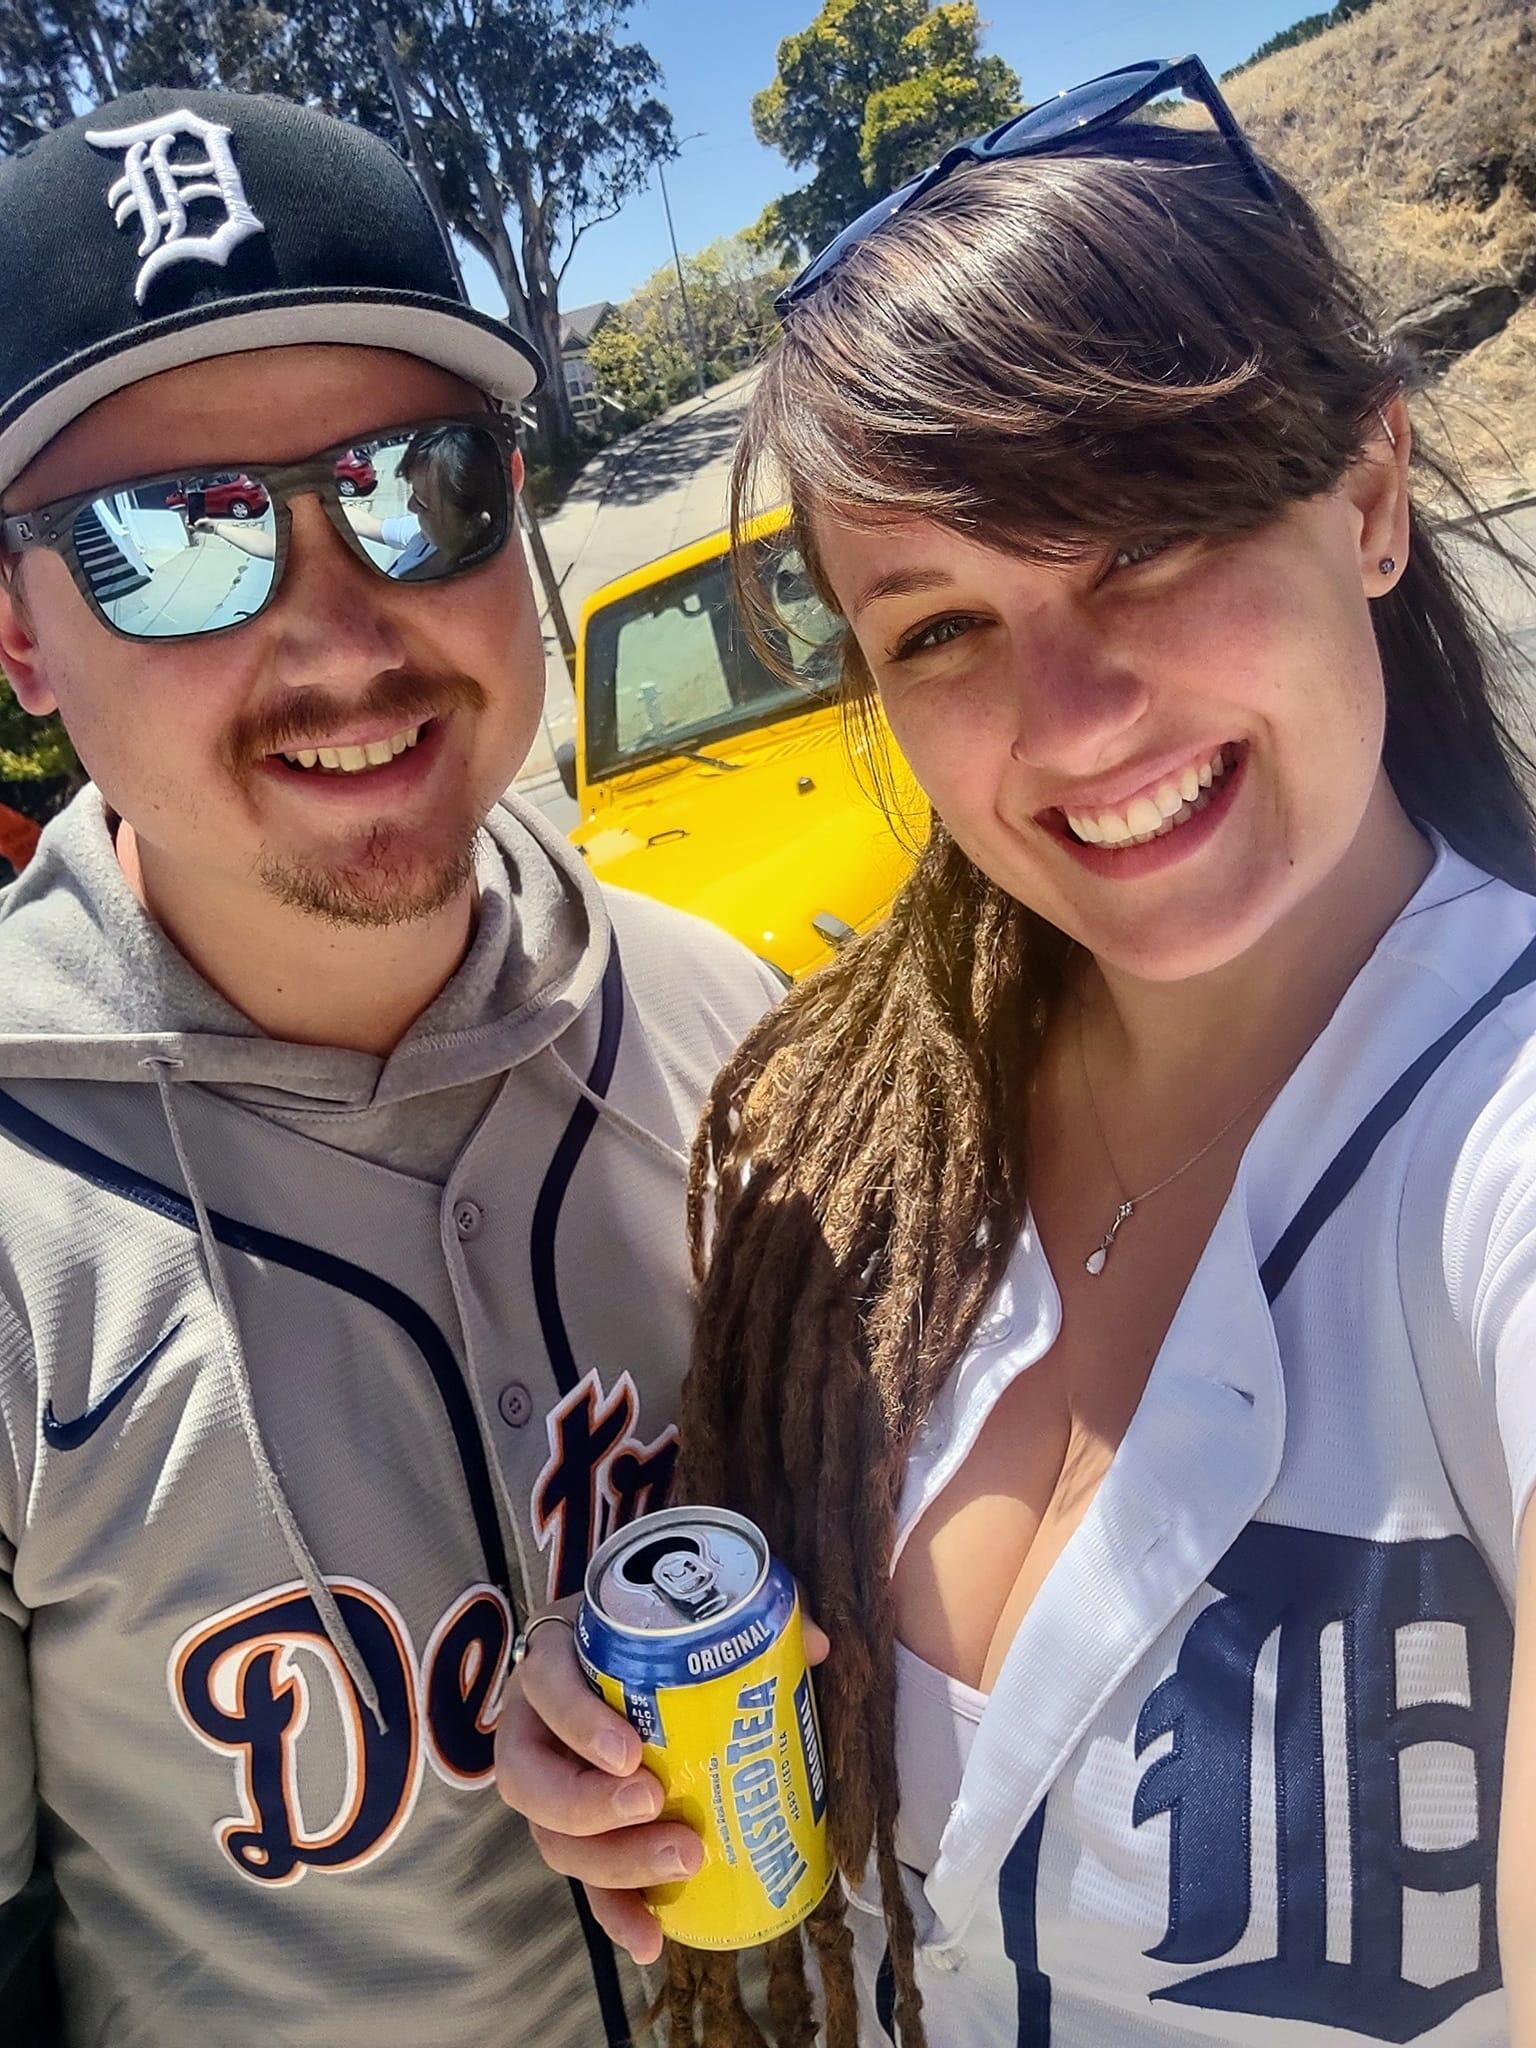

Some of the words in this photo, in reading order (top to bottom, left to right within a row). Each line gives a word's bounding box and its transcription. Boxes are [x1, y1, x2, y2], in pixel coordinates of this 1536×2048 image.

[84, 109, 265, 307] D
[687, 1619, 772, 1676] ORIGINAL
[630, 1694, 648, 1708] 5%
[632, 1708, 655, 1720] ALC.
[638, 1719, 652, 1728] BY
[726, 1676, 777, 1766] TEA
[779, 1730, 788, 1754] TEA
[801, 1688, 824, 1802] ORIGINAL
[709, 1756, 719, 1773] Tea
[781, 1760, 792, 1789] ICED
[1132, 1520, 1516, 2046] D
[715, 1806, 725, 1824] Real
[787, 1791, 800, 1822] HARD
[732, 1758, 808, 1909] TWISTED
